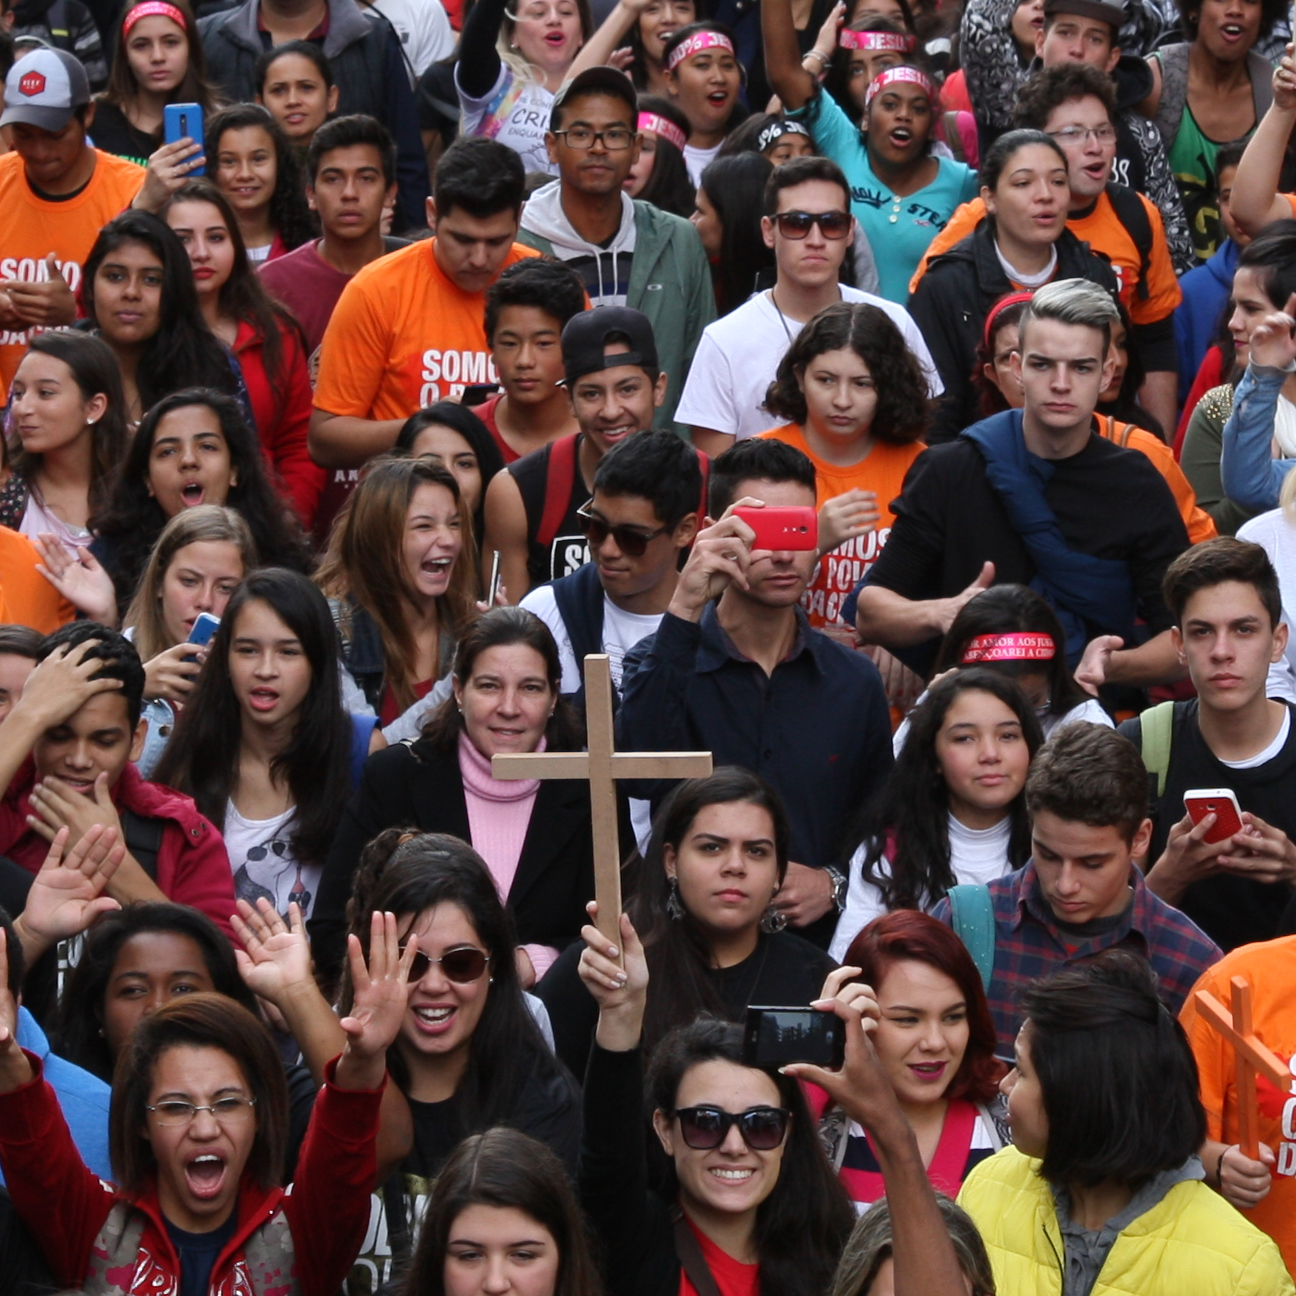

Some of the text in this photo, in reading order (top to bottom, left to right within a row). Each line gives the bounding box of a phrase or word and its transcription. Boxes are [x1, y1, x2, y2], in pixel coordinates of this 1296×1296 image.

[421, 349, 502, 385] SOMO
[982, 637, 1016, 649] AMOR
[1018, 636, 1036, 648] AOS
